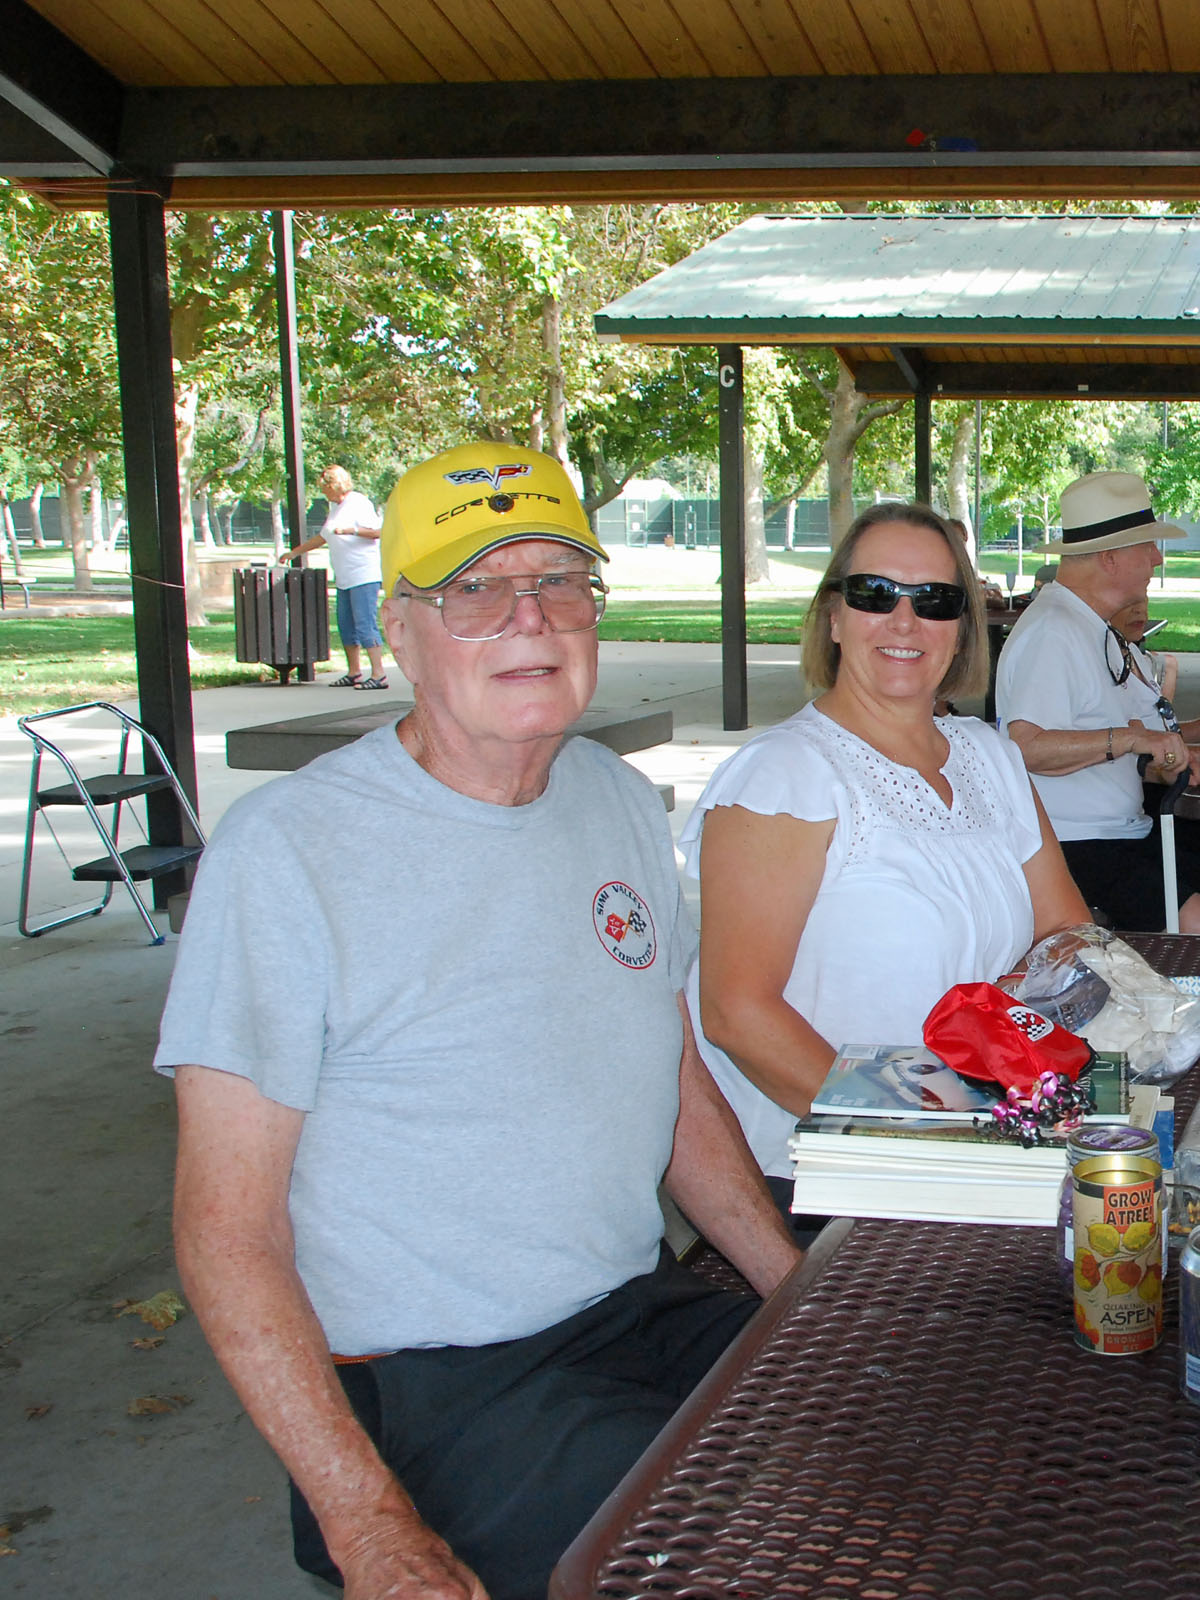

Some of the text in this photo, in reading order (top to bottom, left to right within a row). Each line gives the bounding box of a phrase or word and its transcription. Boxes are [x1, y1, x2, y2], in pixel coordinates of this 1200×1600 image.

[720, 364, 735, 388] C
[434, 492, 560, 525] CORETTE
[596, 884, 643, 916] SIMI VALLEY
[1108, 1189, 1152, 1208] GROW
[1106, 1206, 1153, 1225] A TREE!
[1100, 1306, 1156, 1326] ASPEN
